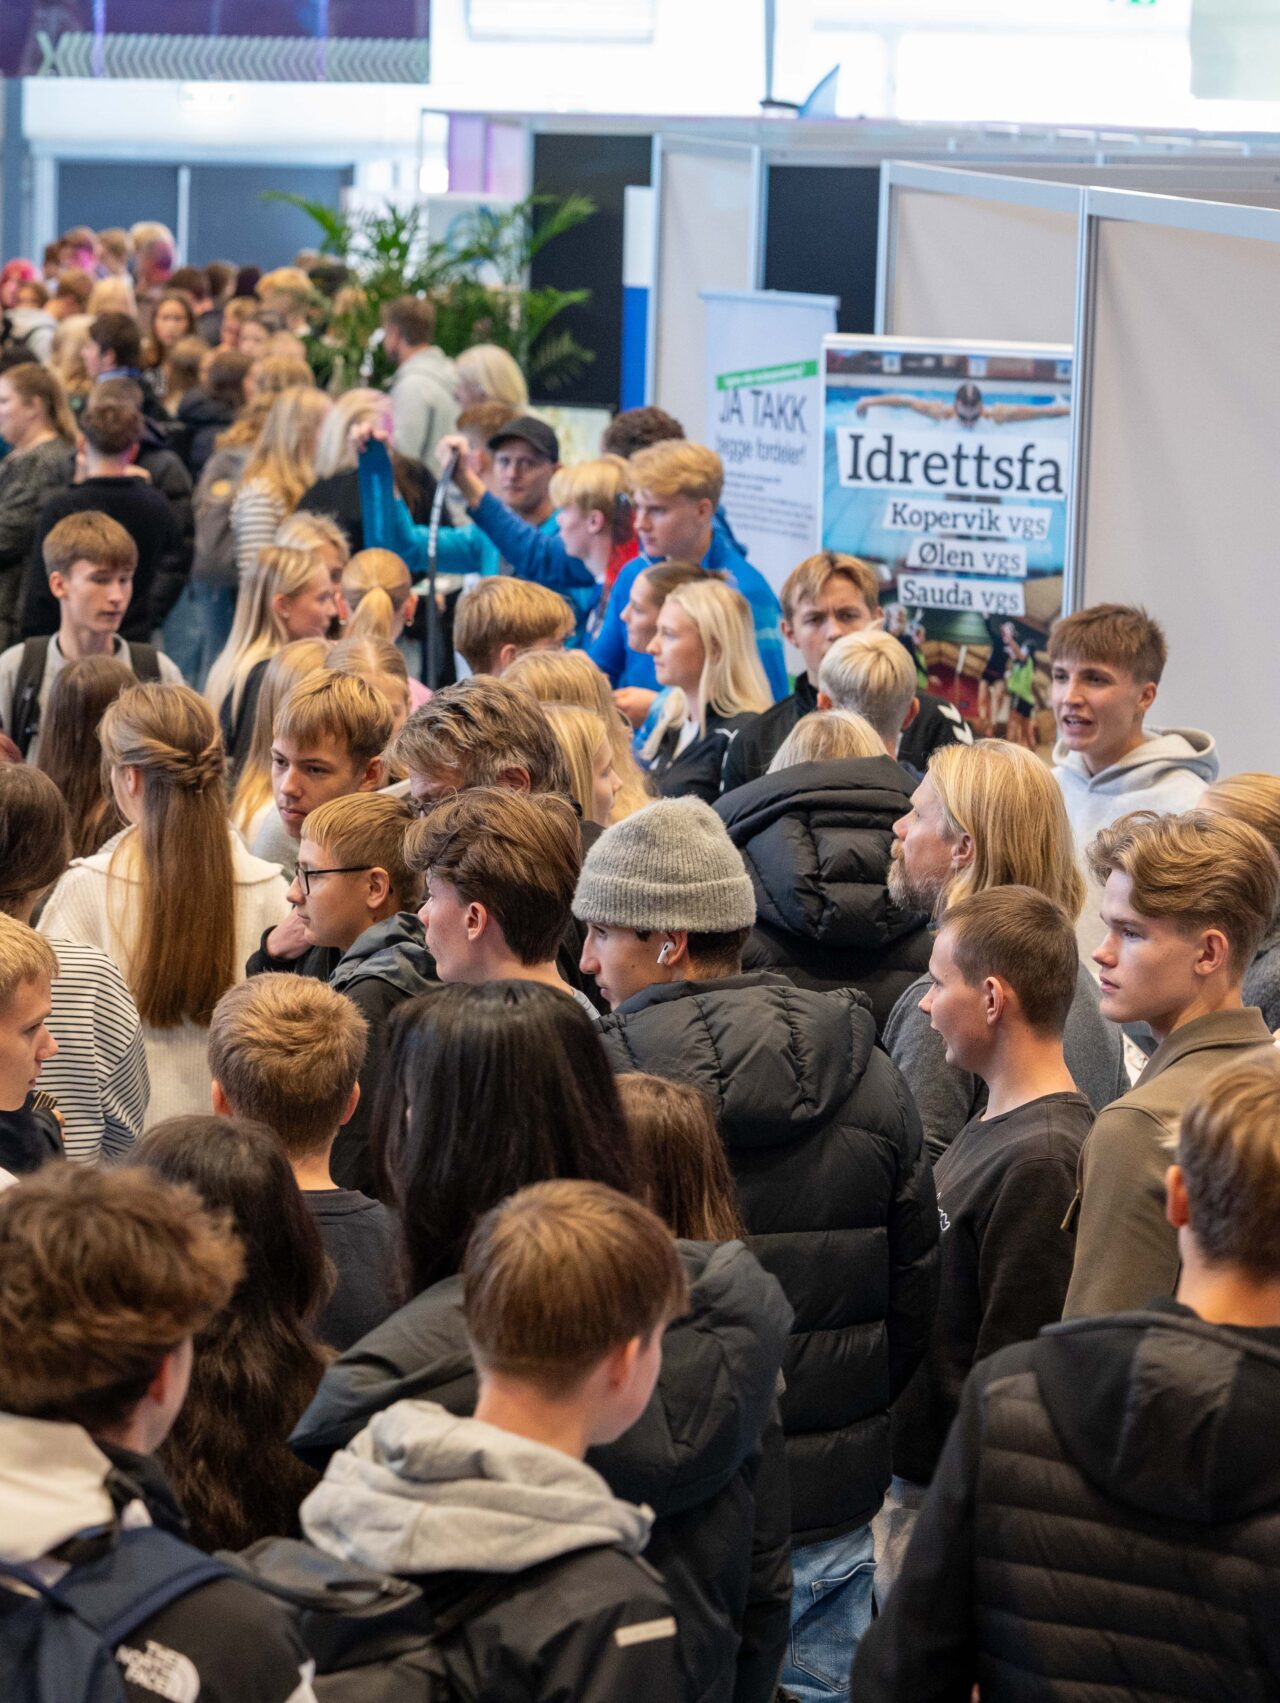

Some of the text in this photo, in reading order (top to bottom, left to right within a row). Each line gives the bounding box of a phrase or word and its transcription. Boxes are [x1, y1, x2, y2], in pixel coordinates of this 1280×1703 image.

[748, 389, 808, 434] TAKK
[847, 433, 1064, 494] Idrettsfa
[891, 502, 1047, 541] Kopervik vgs
[918, 541, 1021, 575] Ølen vgs
[902, 579, 1020, 614] Sauda vgs
